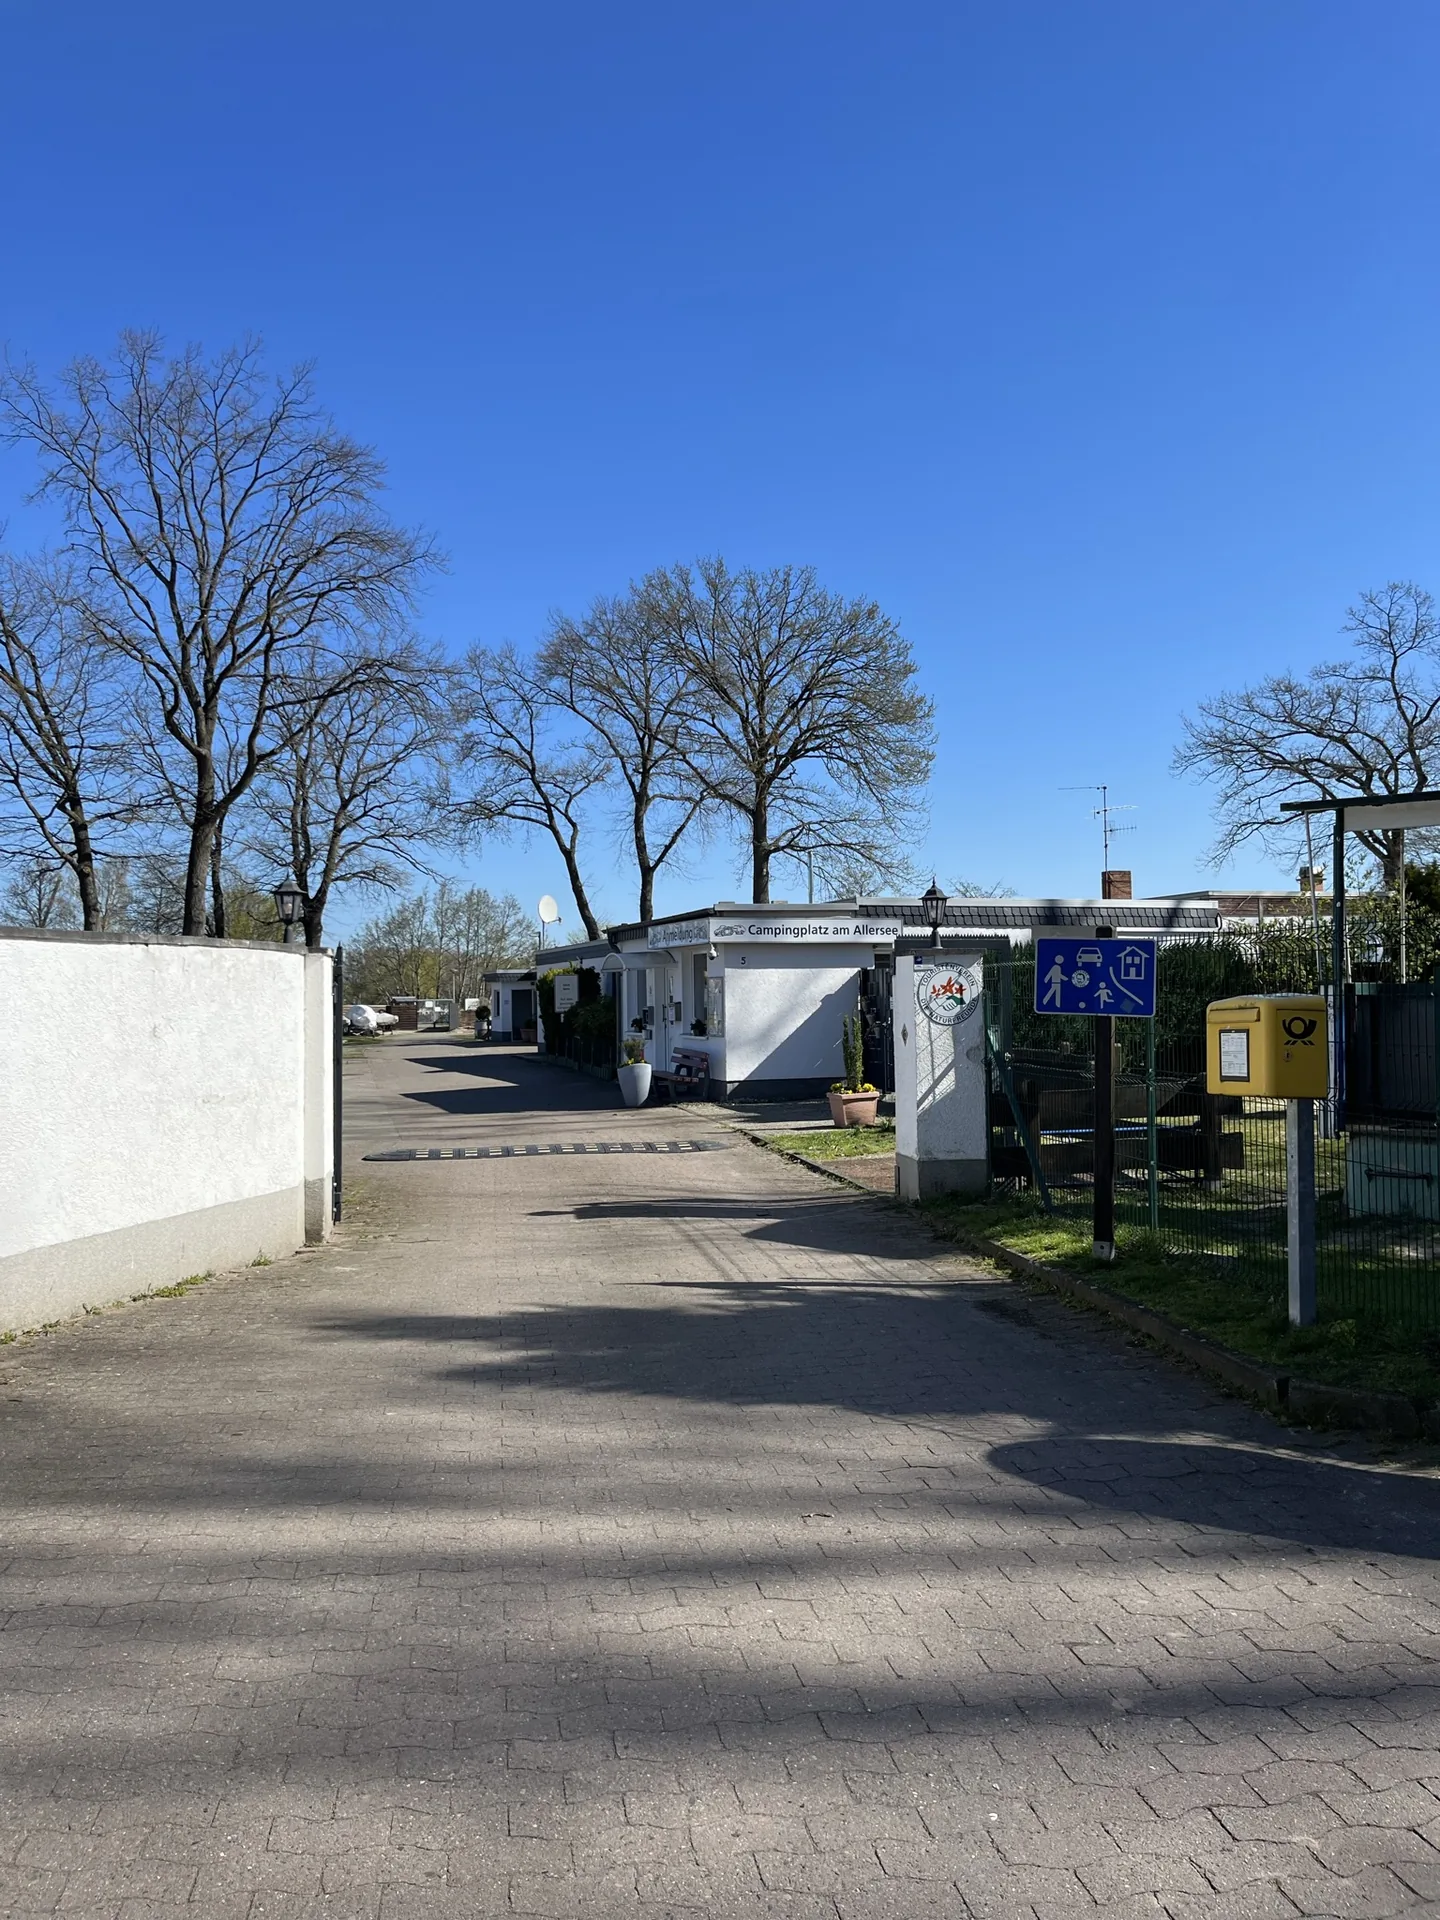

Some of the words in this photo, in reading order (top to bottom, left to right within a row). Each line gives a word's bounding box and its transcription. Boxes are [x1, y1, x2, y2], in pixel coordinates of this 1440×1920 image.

[748, 924, 829, 937] Campingplatz
[832, 926, 850, 936] am
[853, 924, 899, 936] Allersee
[740, 956, 746, 965] 5
[921, 964, 975, 987] TOURISTENVEREIN
